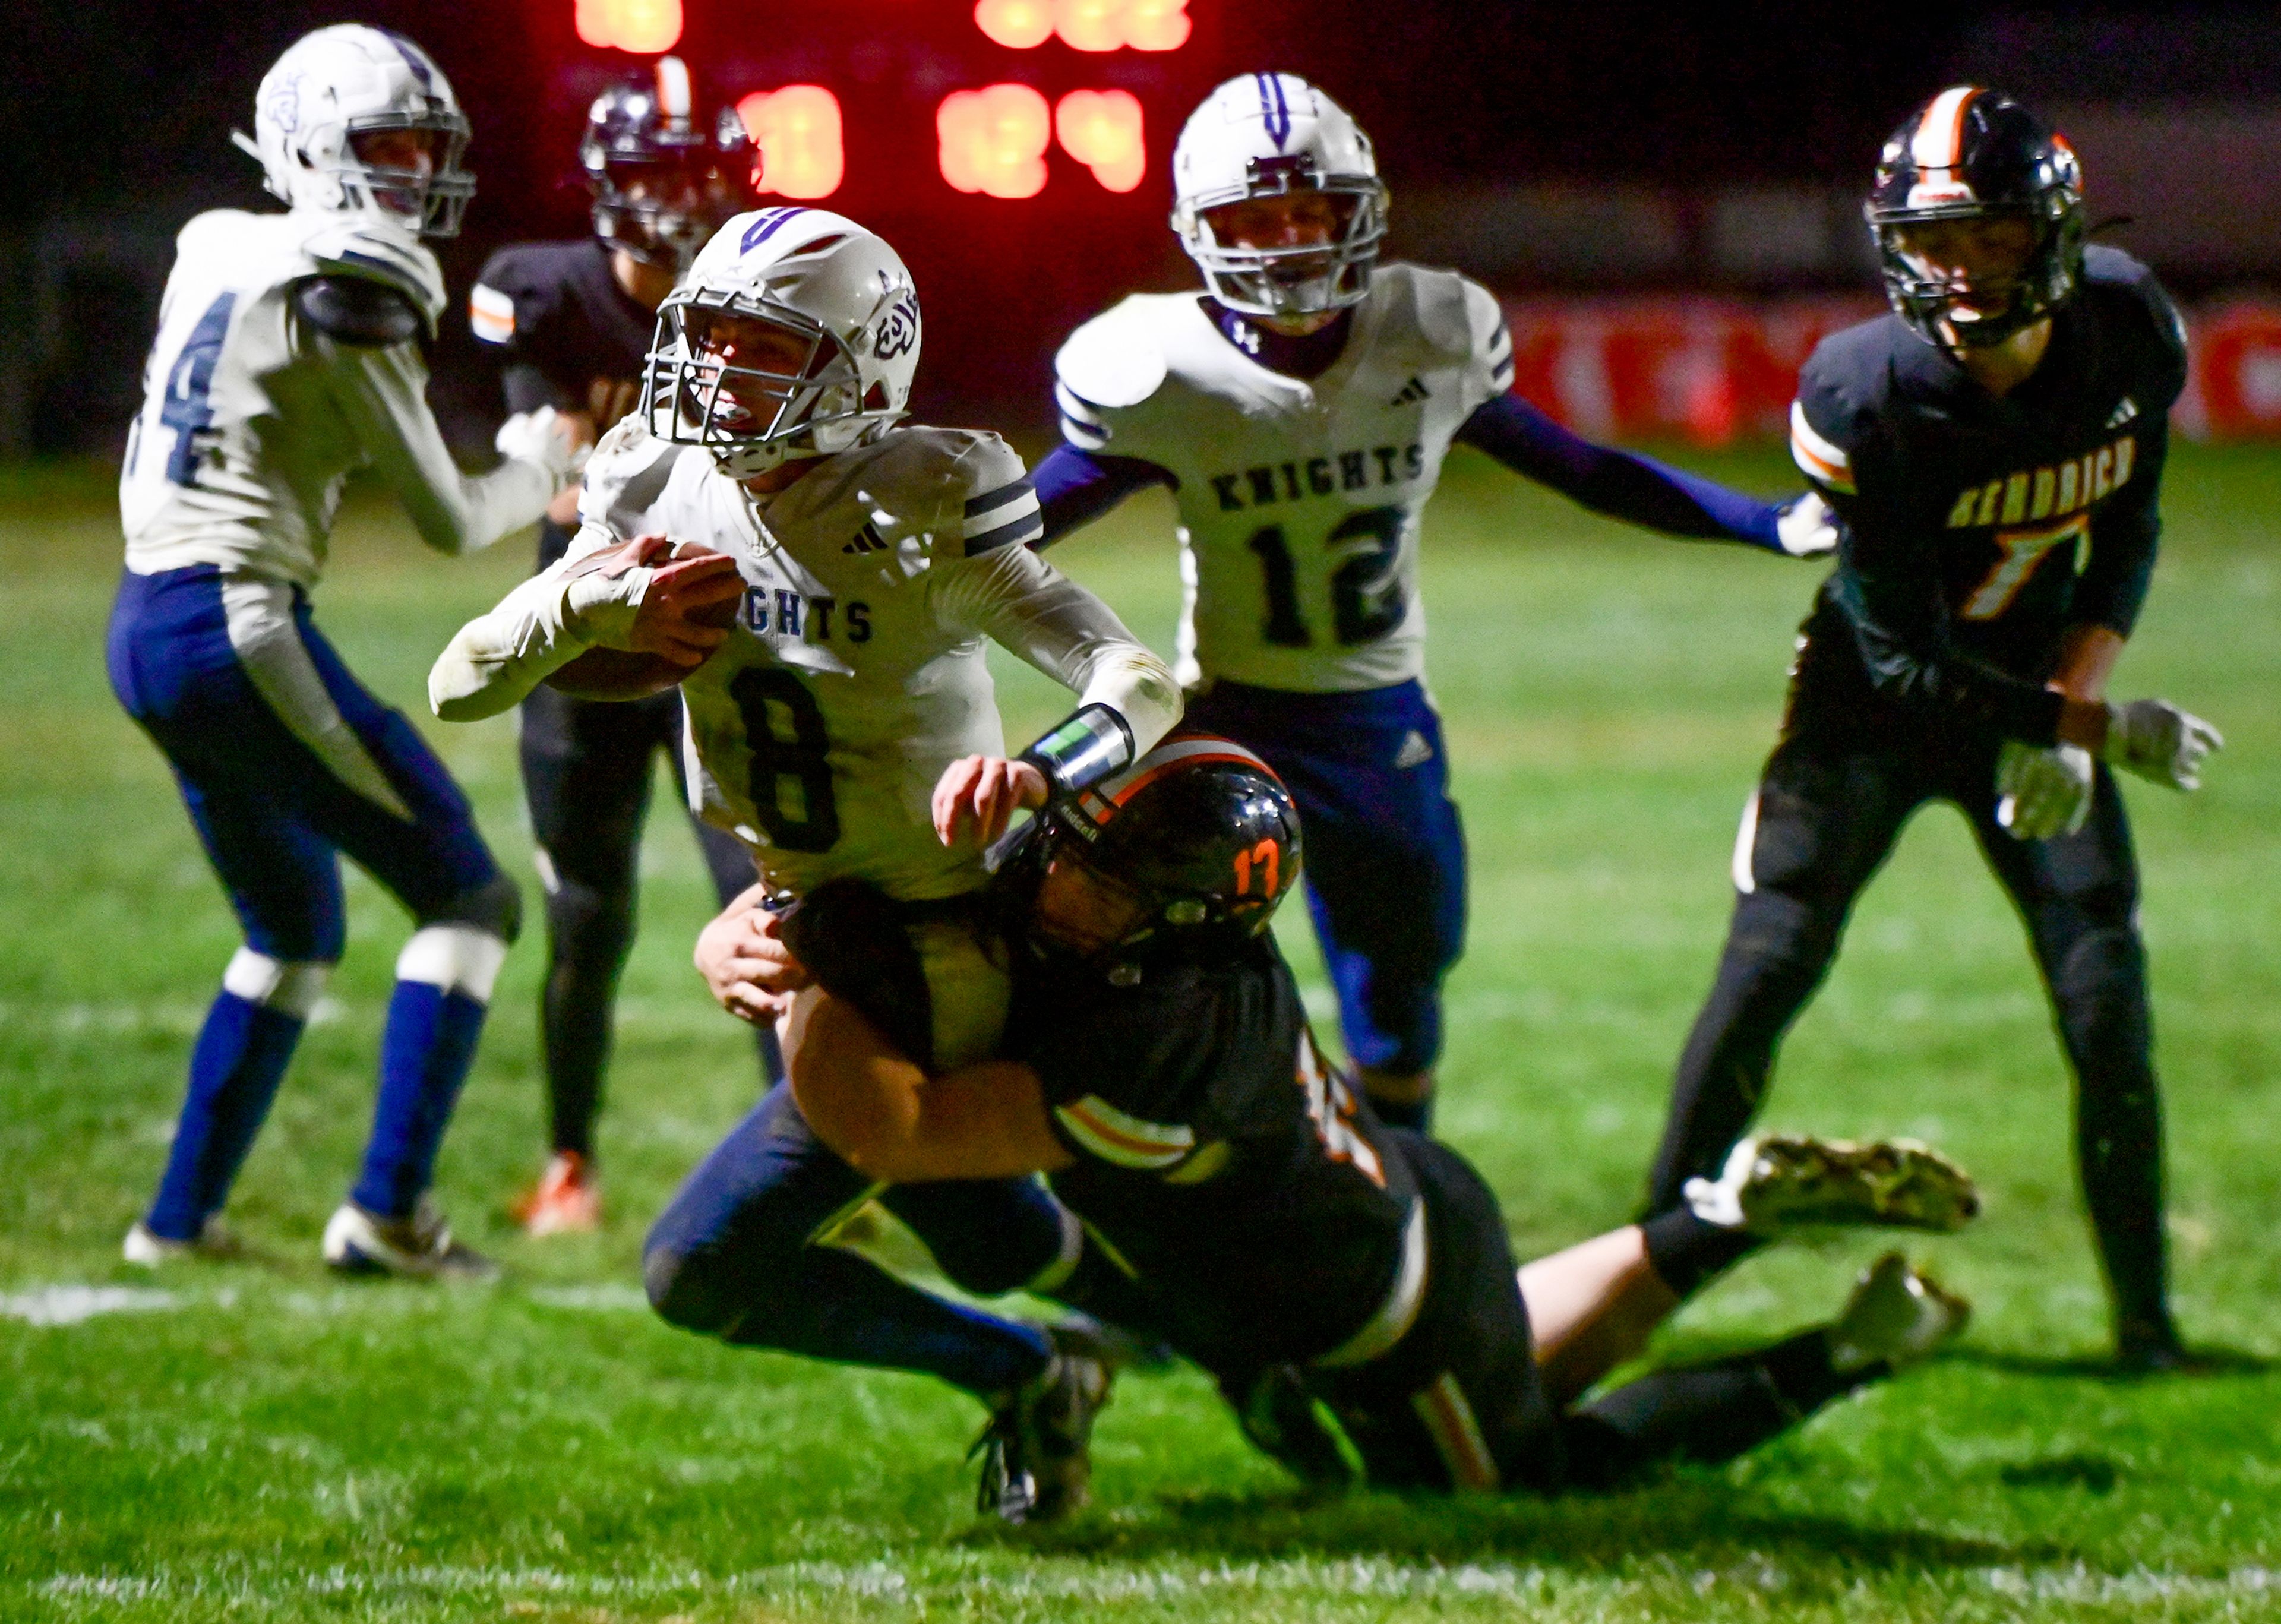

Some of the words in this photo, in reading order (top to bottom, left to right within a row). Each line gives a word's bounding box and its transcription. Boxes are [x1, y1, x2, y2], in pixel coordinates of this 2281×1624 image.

[1209, 444, 1423, 511] KNIGHTS
[1248, 505, 1409, 648] 12
[1961, 512, 2093, 621] 7
[746, 584, 871, 643] GHTS
[731, 666, 841, 854] 8
[1234, 838, 1279, 900] 17
